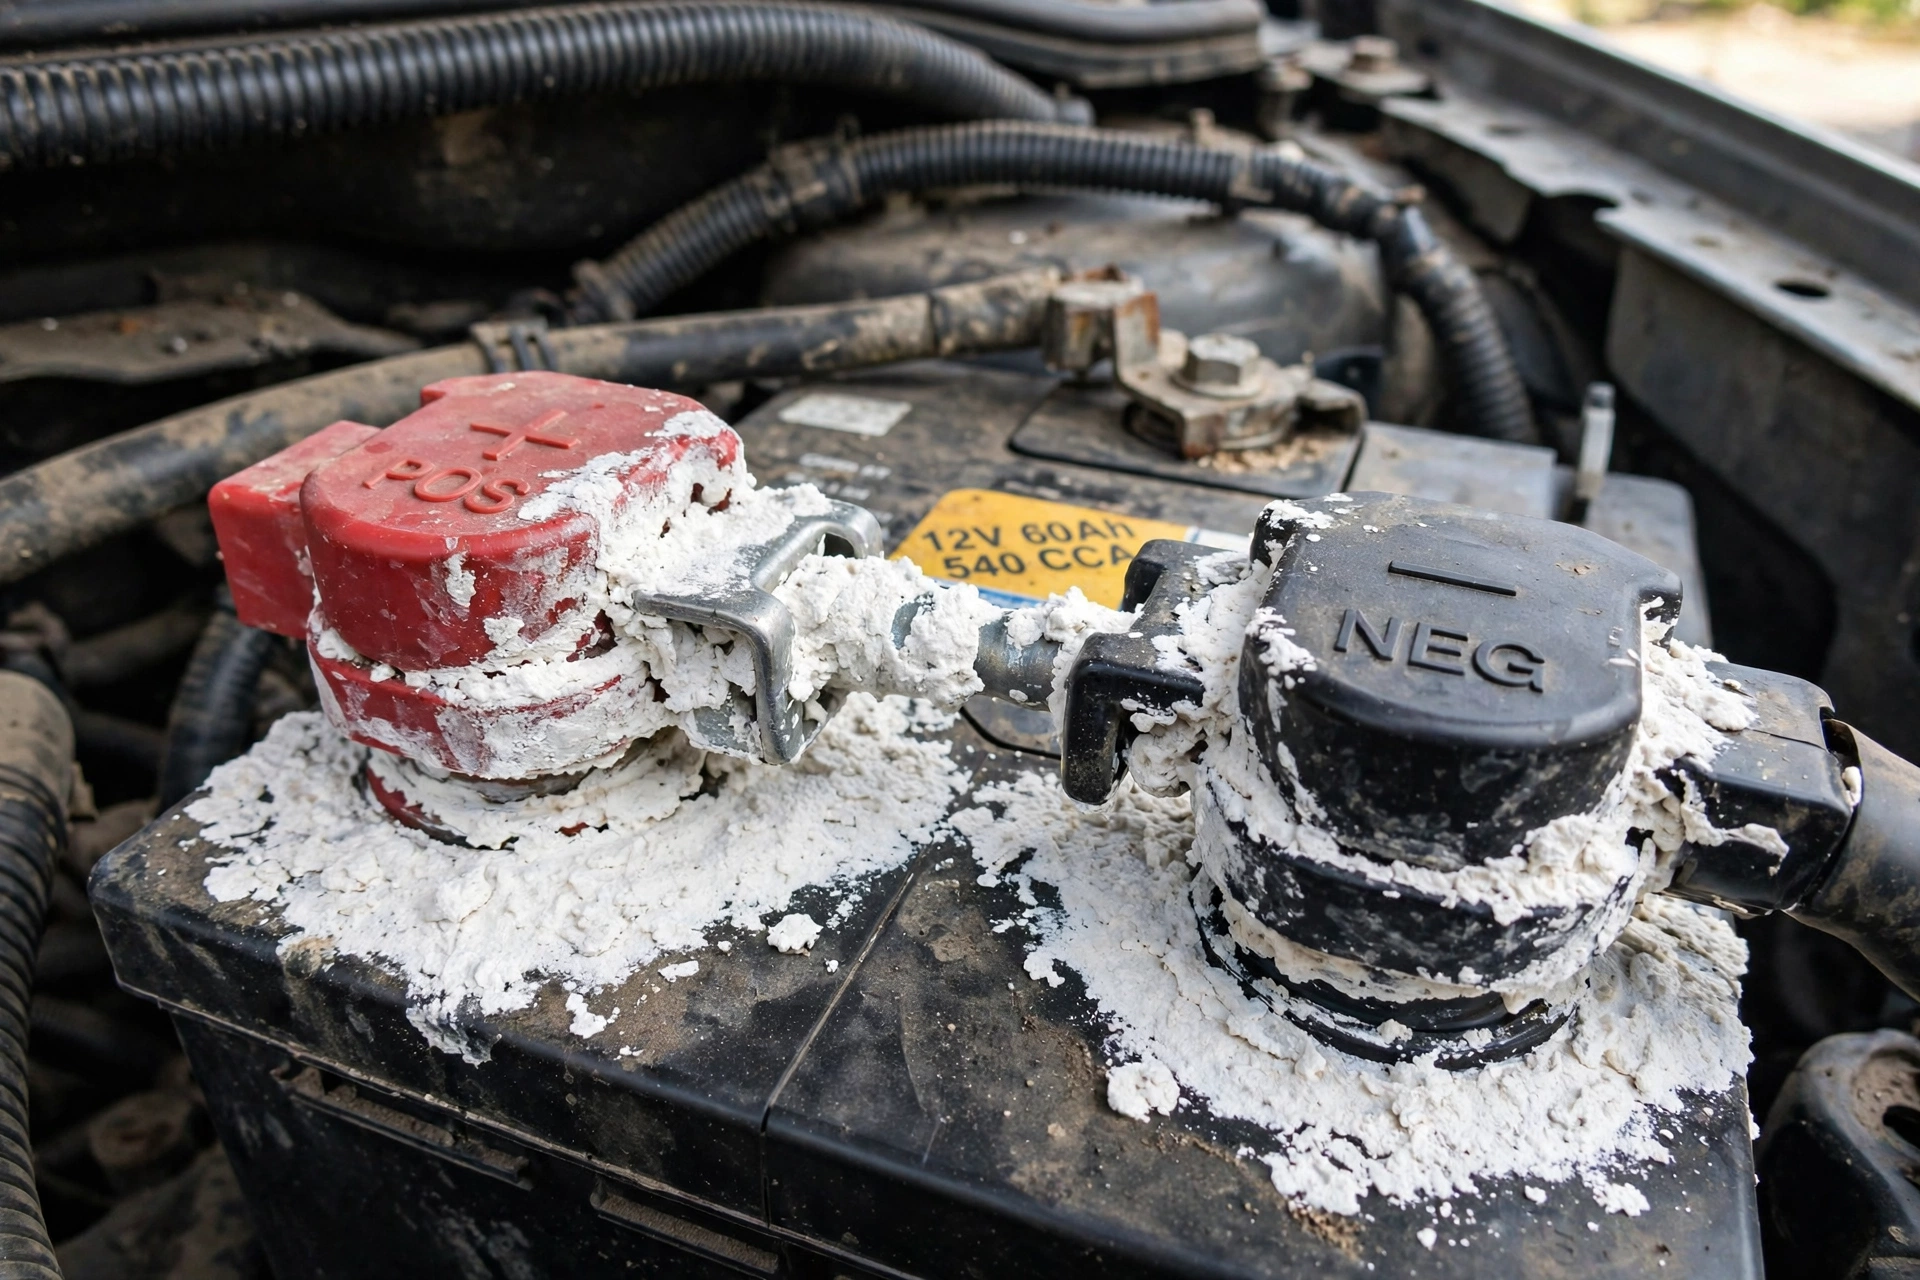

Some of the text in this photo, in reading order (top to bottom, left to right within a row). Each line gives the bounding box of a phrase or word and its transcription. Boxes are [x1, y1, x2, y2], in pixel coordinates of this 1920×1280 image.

[362, 457, 531, 514] POS
[922, 519, 1136, 552] 12V 60Ah
[943, 543, 1136, 580] 540 CCA
[1333, 608, 1546, 694] NEG
